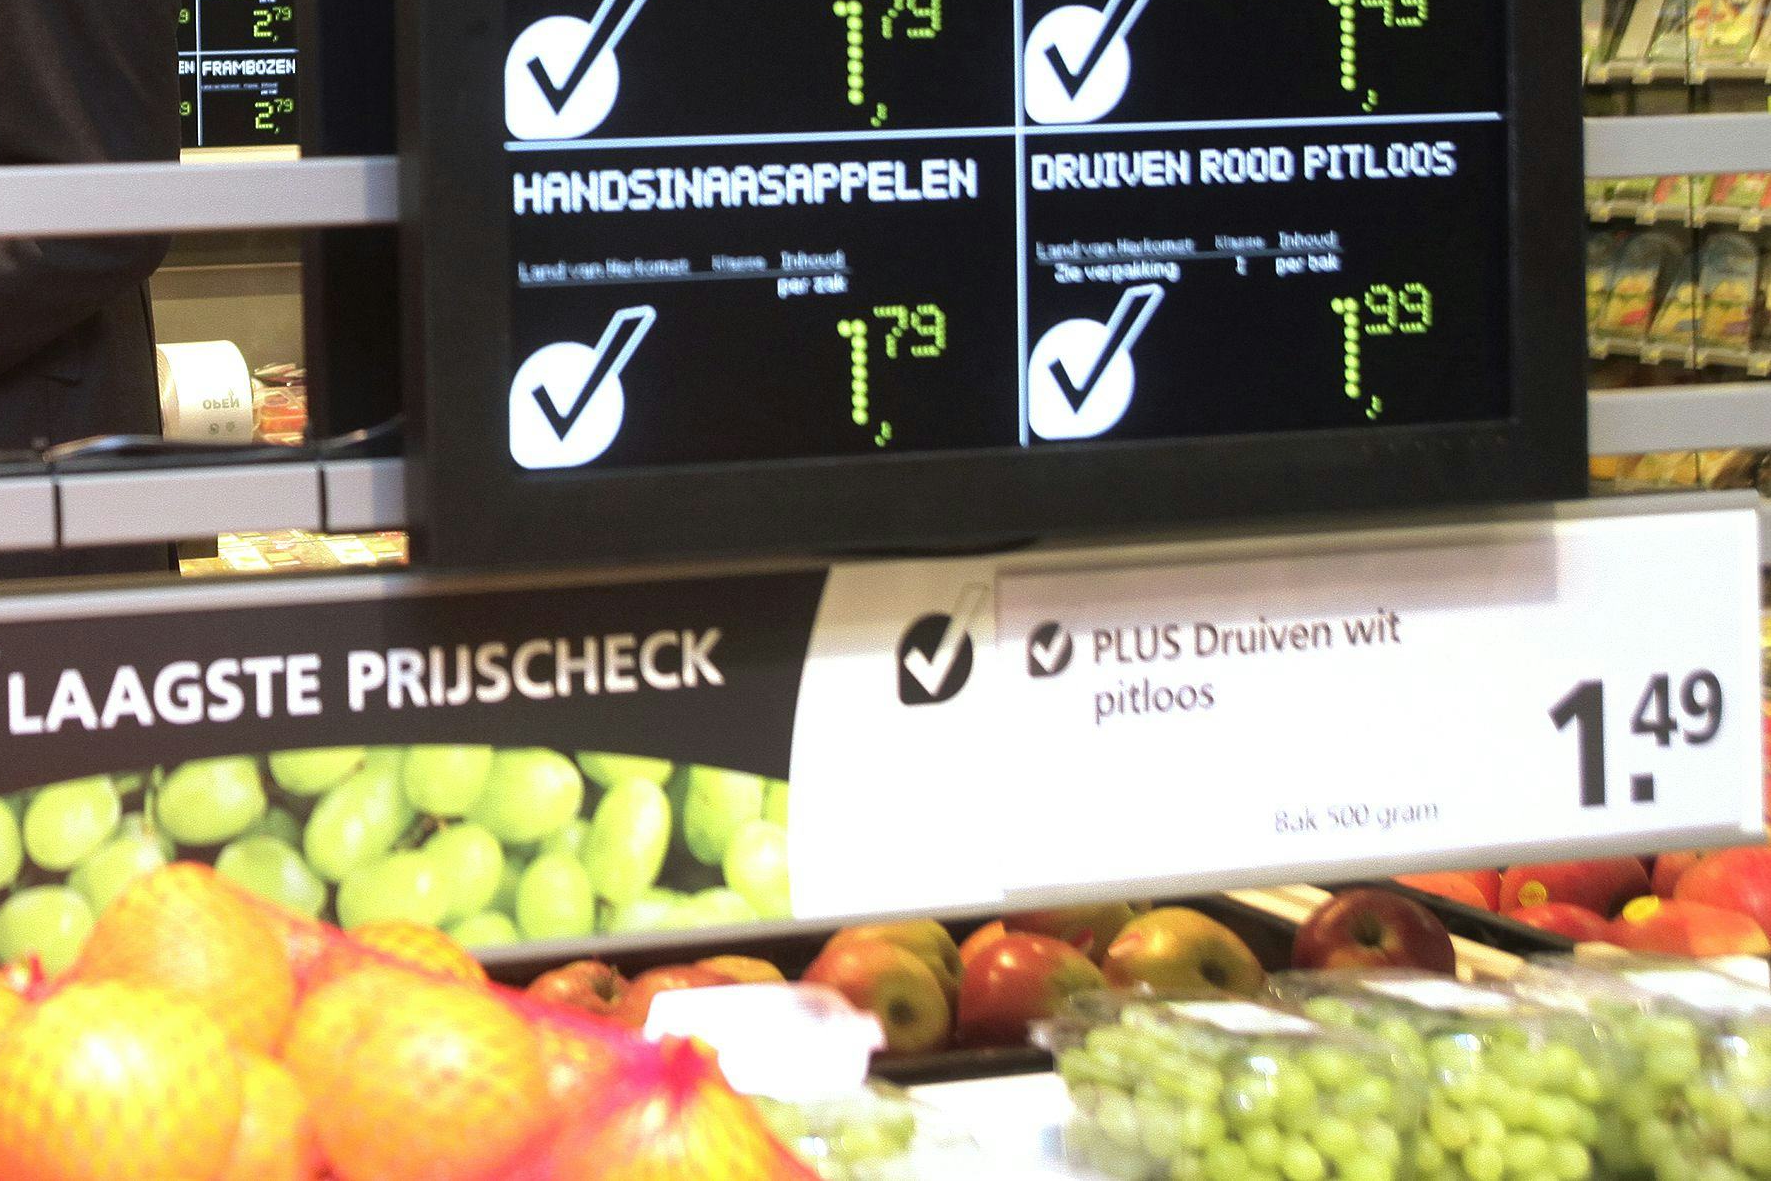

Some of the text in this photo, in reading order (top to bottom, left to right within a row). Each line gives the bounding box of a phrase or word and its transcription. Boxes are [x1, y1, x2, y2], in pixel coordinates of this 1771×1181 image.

[201, 58, 296, 77] FRAMBOZEN
[513, 157, 979, 215] HANDSINAASAPPELEN
[1030, 140, 1458, 192] DRUIVEN ROOD PITLOOS
[1092, 608, 1402, 666] PLUS Druiven wit
[8, 627, 725, 736] LAAGSTE PRIJSCHECK
[1093, 680, 1217, 726] pitloos
[1547, 667, 1725, 809] 1.49
